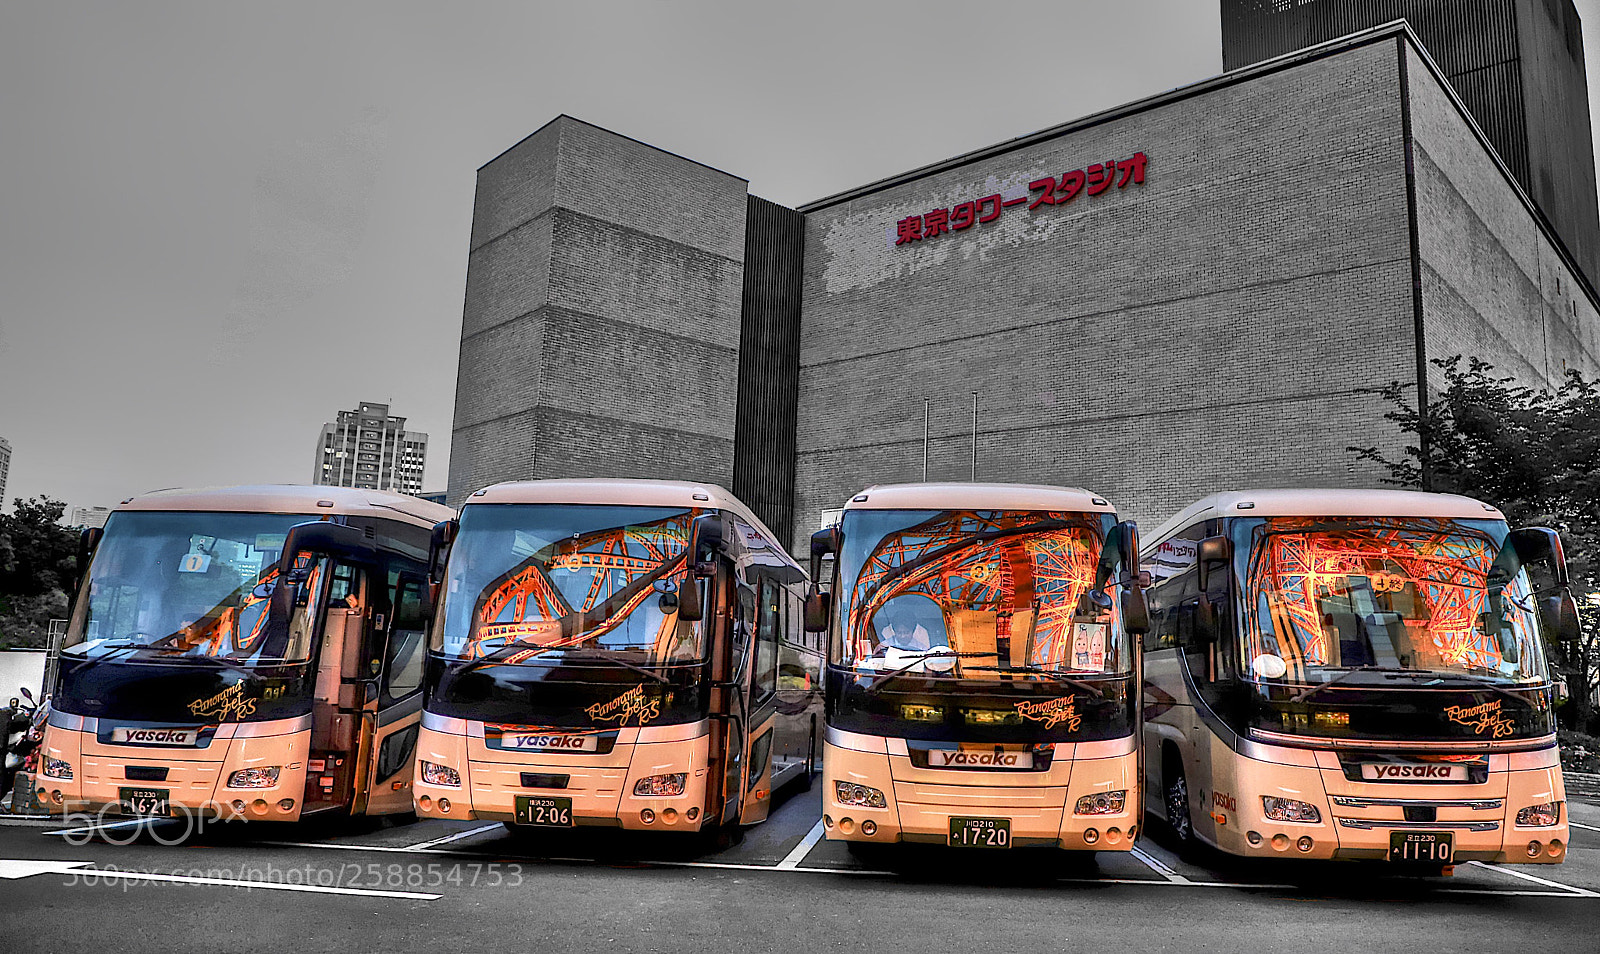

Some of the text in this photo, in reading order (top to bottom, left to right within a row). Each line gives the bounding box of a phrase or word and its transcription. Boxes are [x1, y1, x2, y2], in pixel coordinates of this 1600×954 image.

[896, 151, 1148, 246] 東京タワースタジオ
[187, 680, 243, 716] Panorama
[584, 683, 643, 721] Panorama
[1013, 694, 1075, 720] Panorama
[1443, 699, 1502, 725] Panorama
[125, 730, 188, 743] yasaka
[516, 735, 585, 749] yasaka
[942, 752, 1018, 766] yasaka
[1373, 765, 1452, 779] yasaka
[962, 827, 1007, 846] 17-20
[1403, 841, 1449, 860] 11-10
